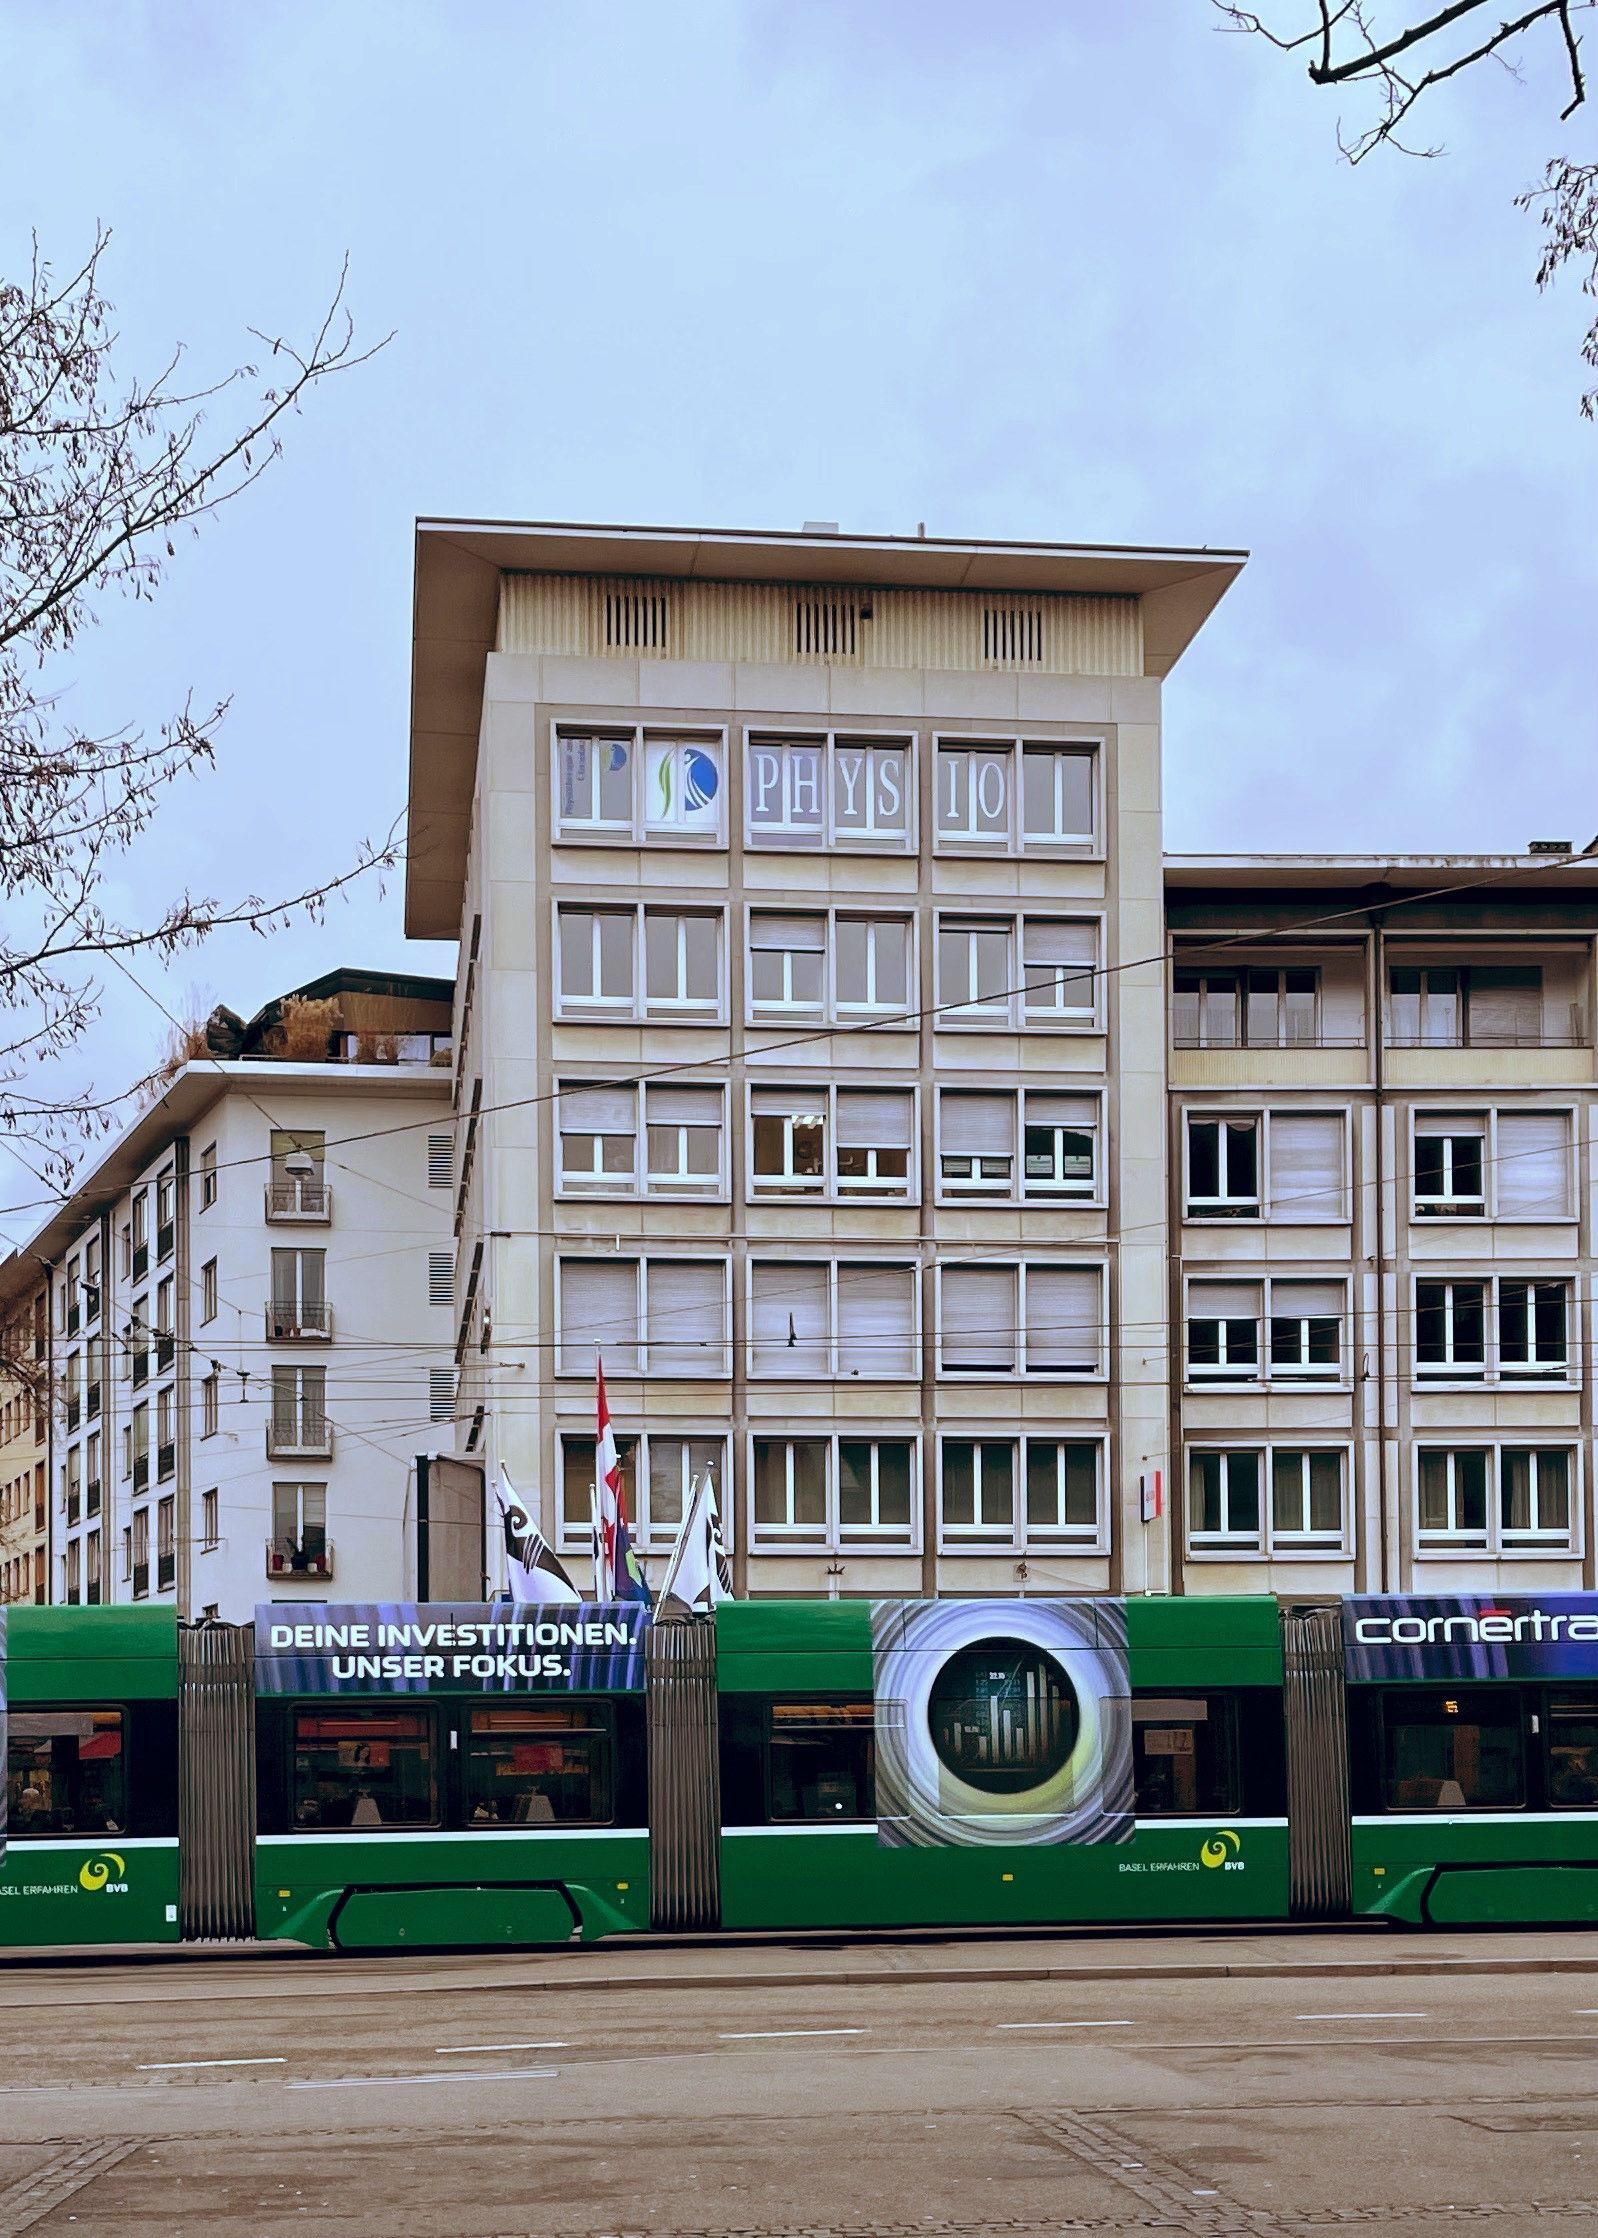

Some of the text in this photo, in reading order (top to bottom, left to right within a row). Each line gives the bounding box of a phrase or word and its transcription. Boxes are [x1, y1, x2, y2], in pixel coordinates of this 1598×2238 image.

[755, 754, 1005, 819] PHYSIO
[270, 1623, 638, 1648] DEINE INVESTITIONEN.
[331, 1654, 572, 1679] UNSER FOKUS.
[1119, 1862, 1200, 1872] BASEL ERFAHREN
[1225, 1862, 1245, 1870] BVB
[23, 1885, 78, 1895] ERFAHREN
[106, 1883, 128, 1893] BVB
